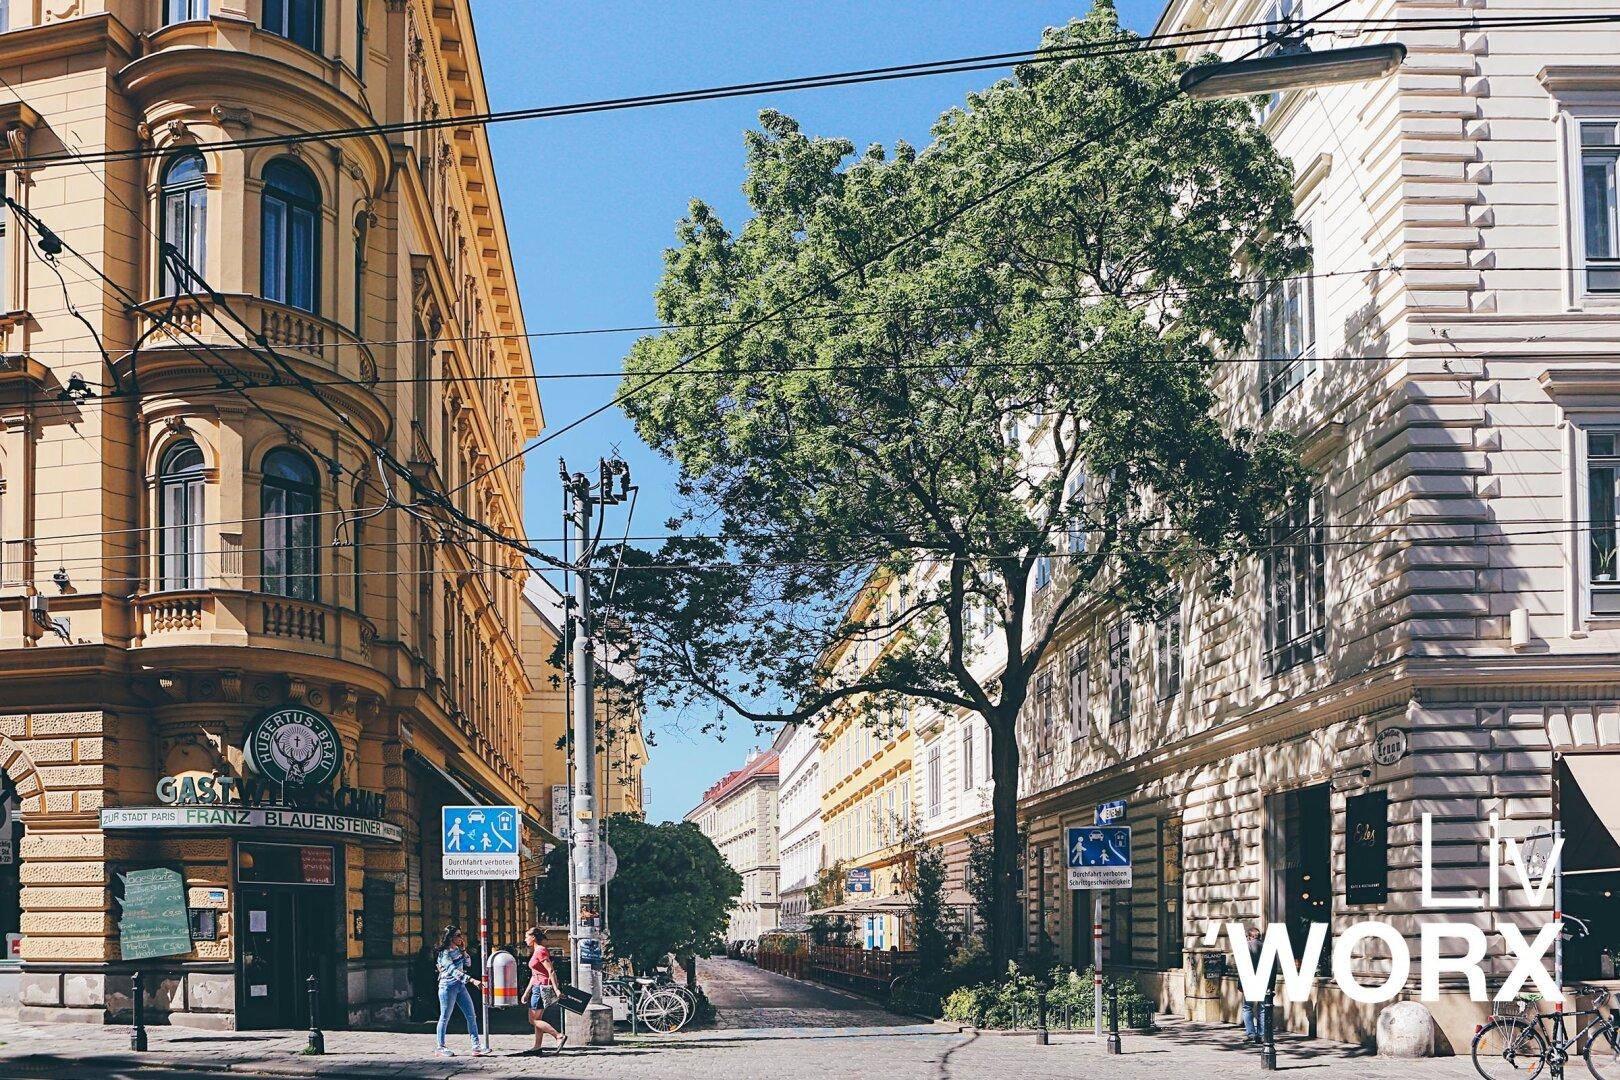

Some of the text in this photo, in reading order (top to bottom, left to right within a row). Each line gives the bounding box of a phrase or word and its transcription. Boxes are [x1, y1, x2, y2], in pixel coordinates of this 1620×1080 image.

[258, 712, 335, 770] HUBERTUS-BRÄU
[103, 812, 119, 825] ZUR
[121, 812, 148, 822] STADT
[151, 812, 176, 821] PARIS
[186, 809, 250, 825] FRANZ
[265, 811, 381, 835] BLAUENSTEINER
[448, 858, 483, 866] Durchfahrt
[444, 867, 517, 877] Schrittgeschwindigkeit
